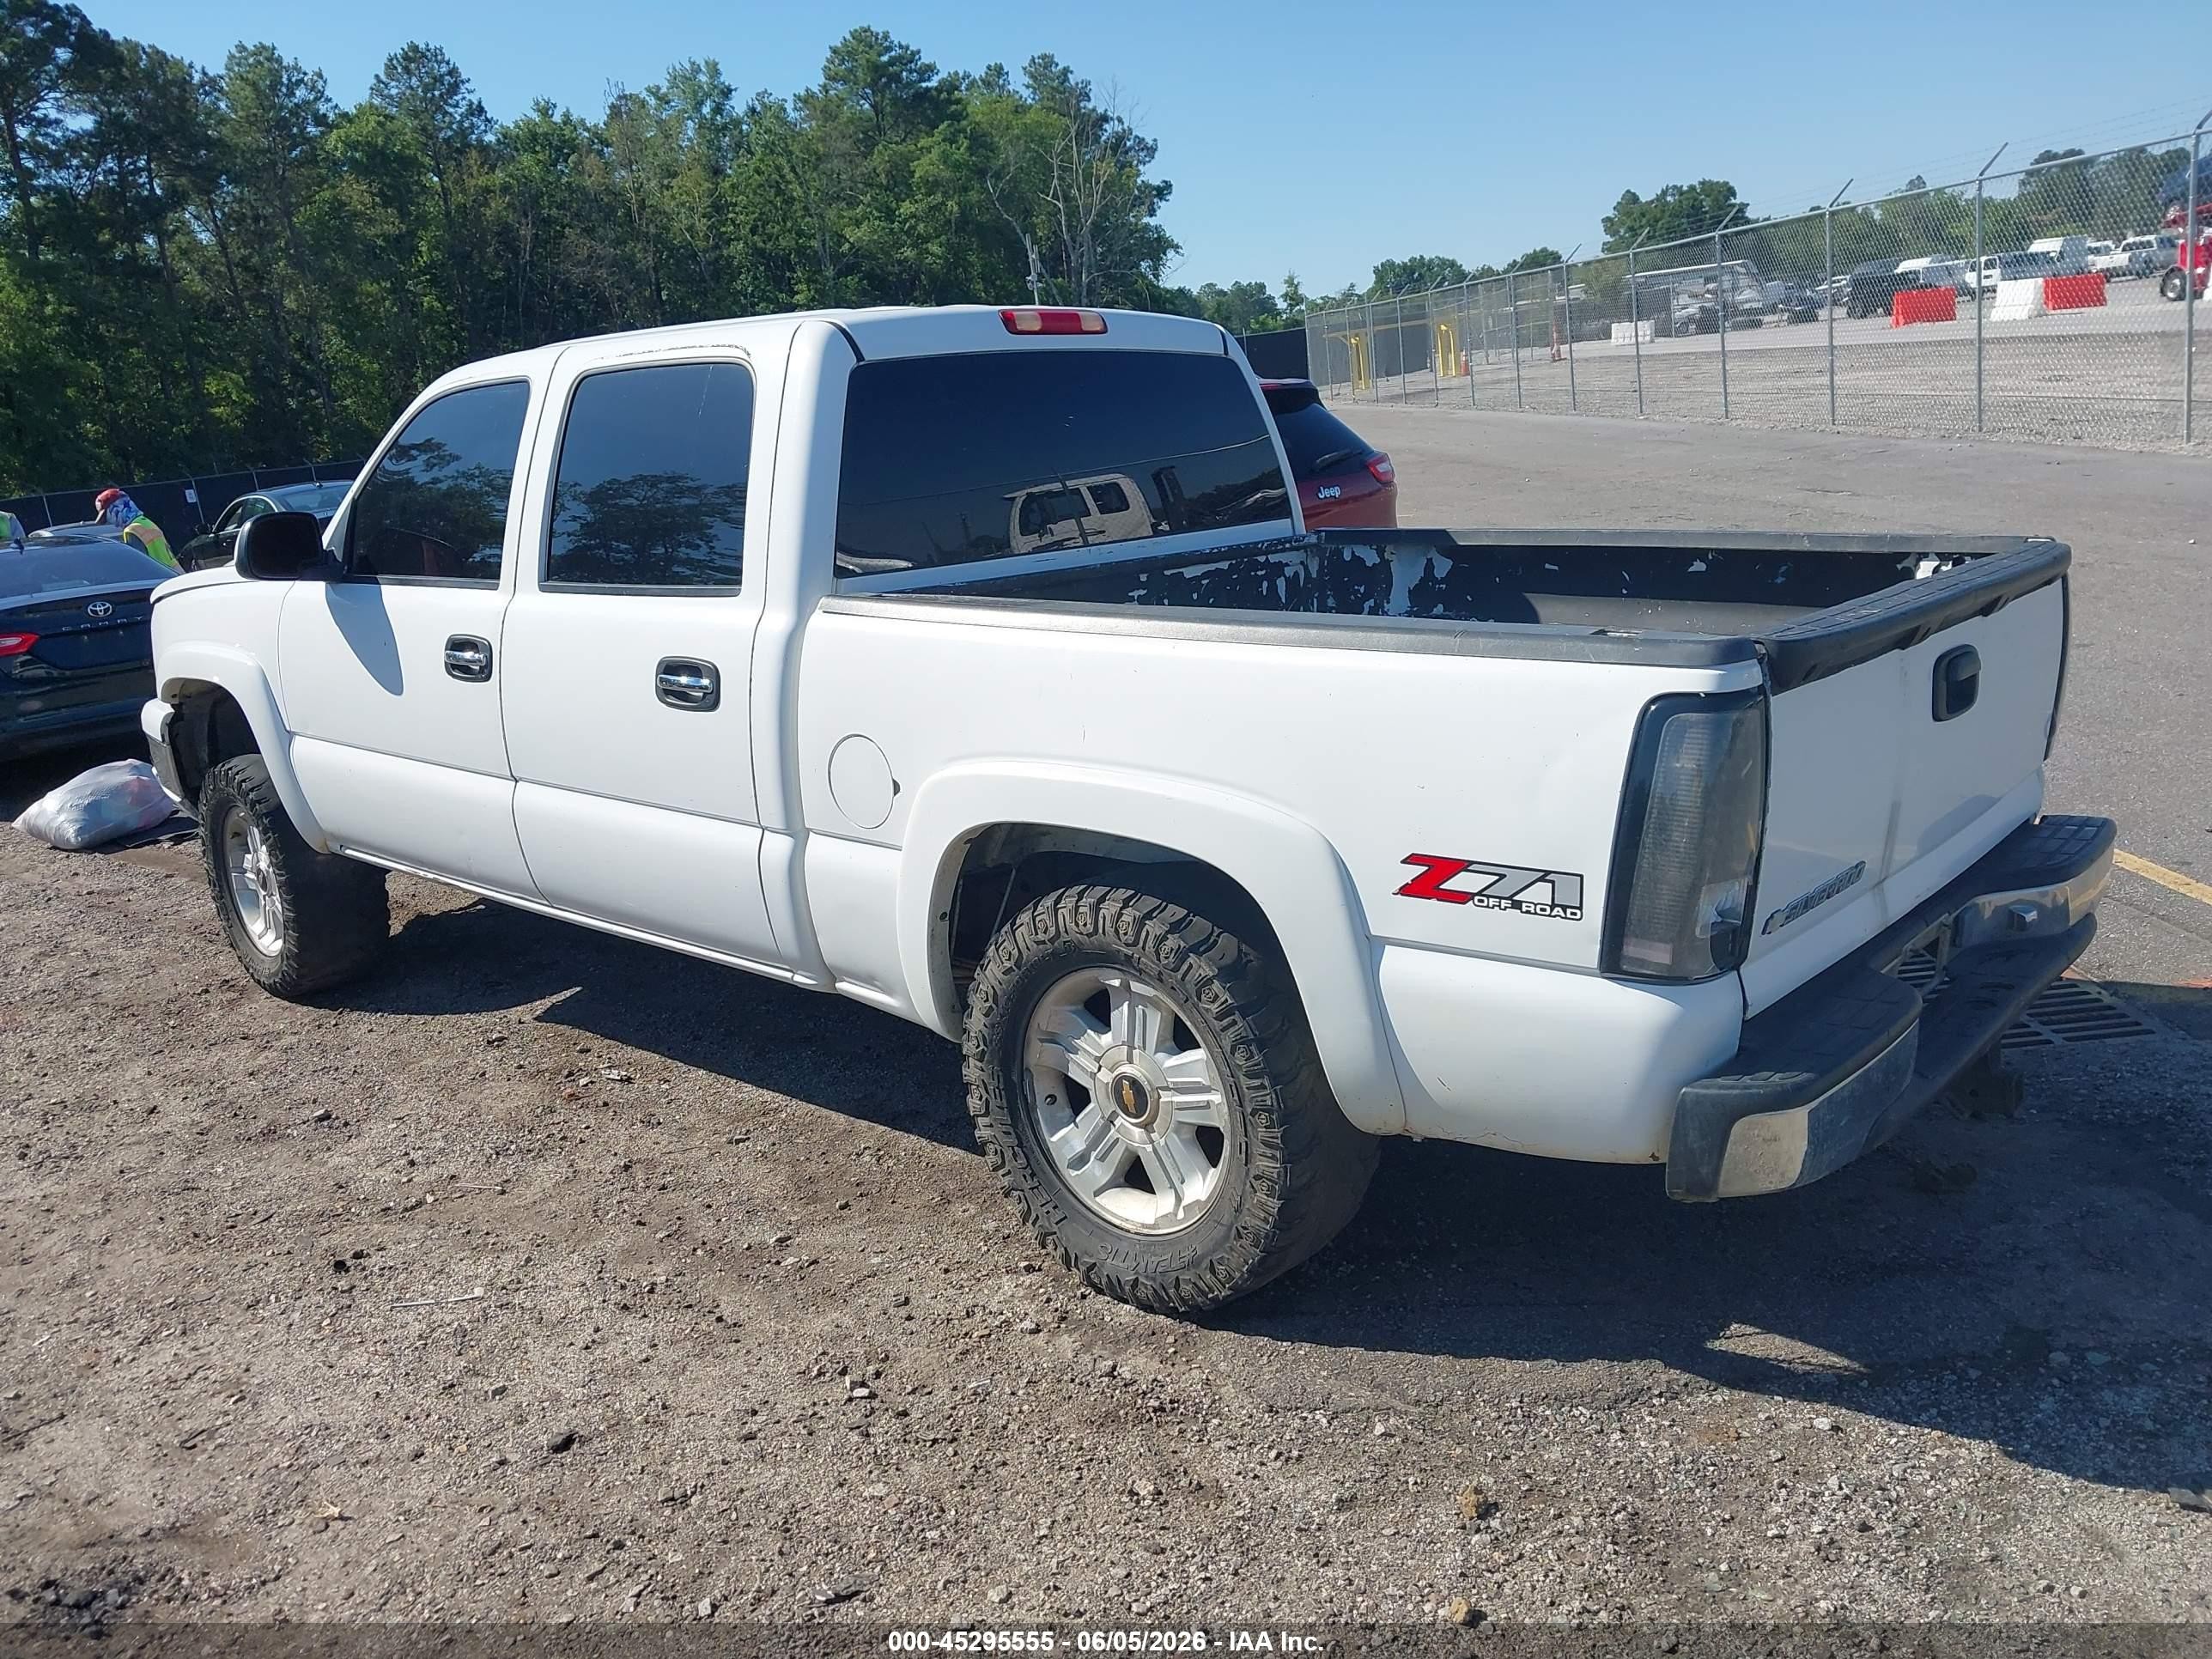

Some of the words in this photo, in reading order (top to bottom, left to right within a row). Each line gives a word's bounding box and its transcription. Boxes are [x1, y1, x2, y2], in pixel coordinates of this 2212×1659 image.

[1317, 485, 1341, 499] Jeep
[1392, 853, 1584, 907] Z71
[1474, 896, 1512, 910] OFF
[1522, 902, 1582, 920] ROAD
[989, 1065, 1067, 1226] HERCULES
